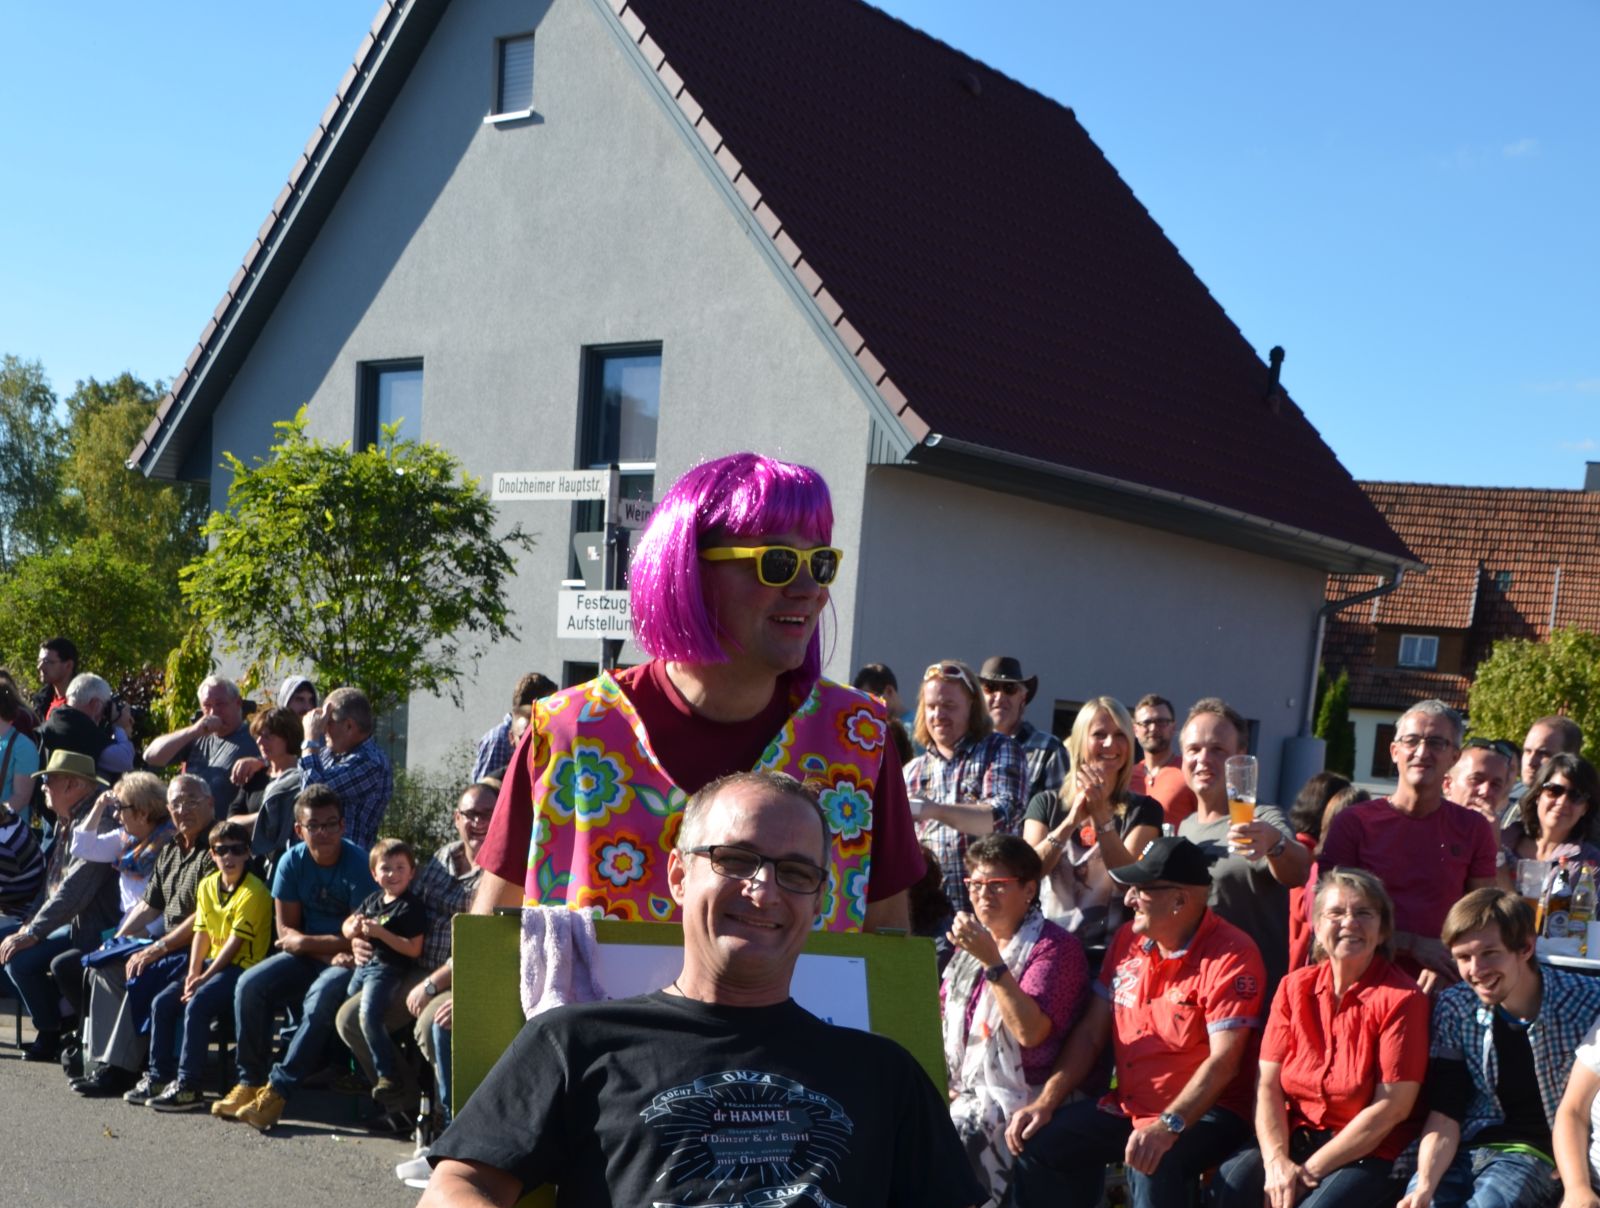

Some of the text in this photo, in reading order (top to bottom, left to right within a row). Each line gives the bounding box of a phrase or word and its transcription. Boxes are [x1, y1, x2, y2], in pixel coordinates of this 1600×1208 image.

[498, 476, 601, 496] Onolzheimer Hauptstr.
[625, 503, 655, 522] Wein
[567, 615, 632, 631] Aufstellun
[721, 1071, 772, 1084] ONZA
[713, 1108, 796, 1124] dr HAMMEL
[765, 1132, 778, 1142] dr
[717, 1155, 736, 1166] mir
